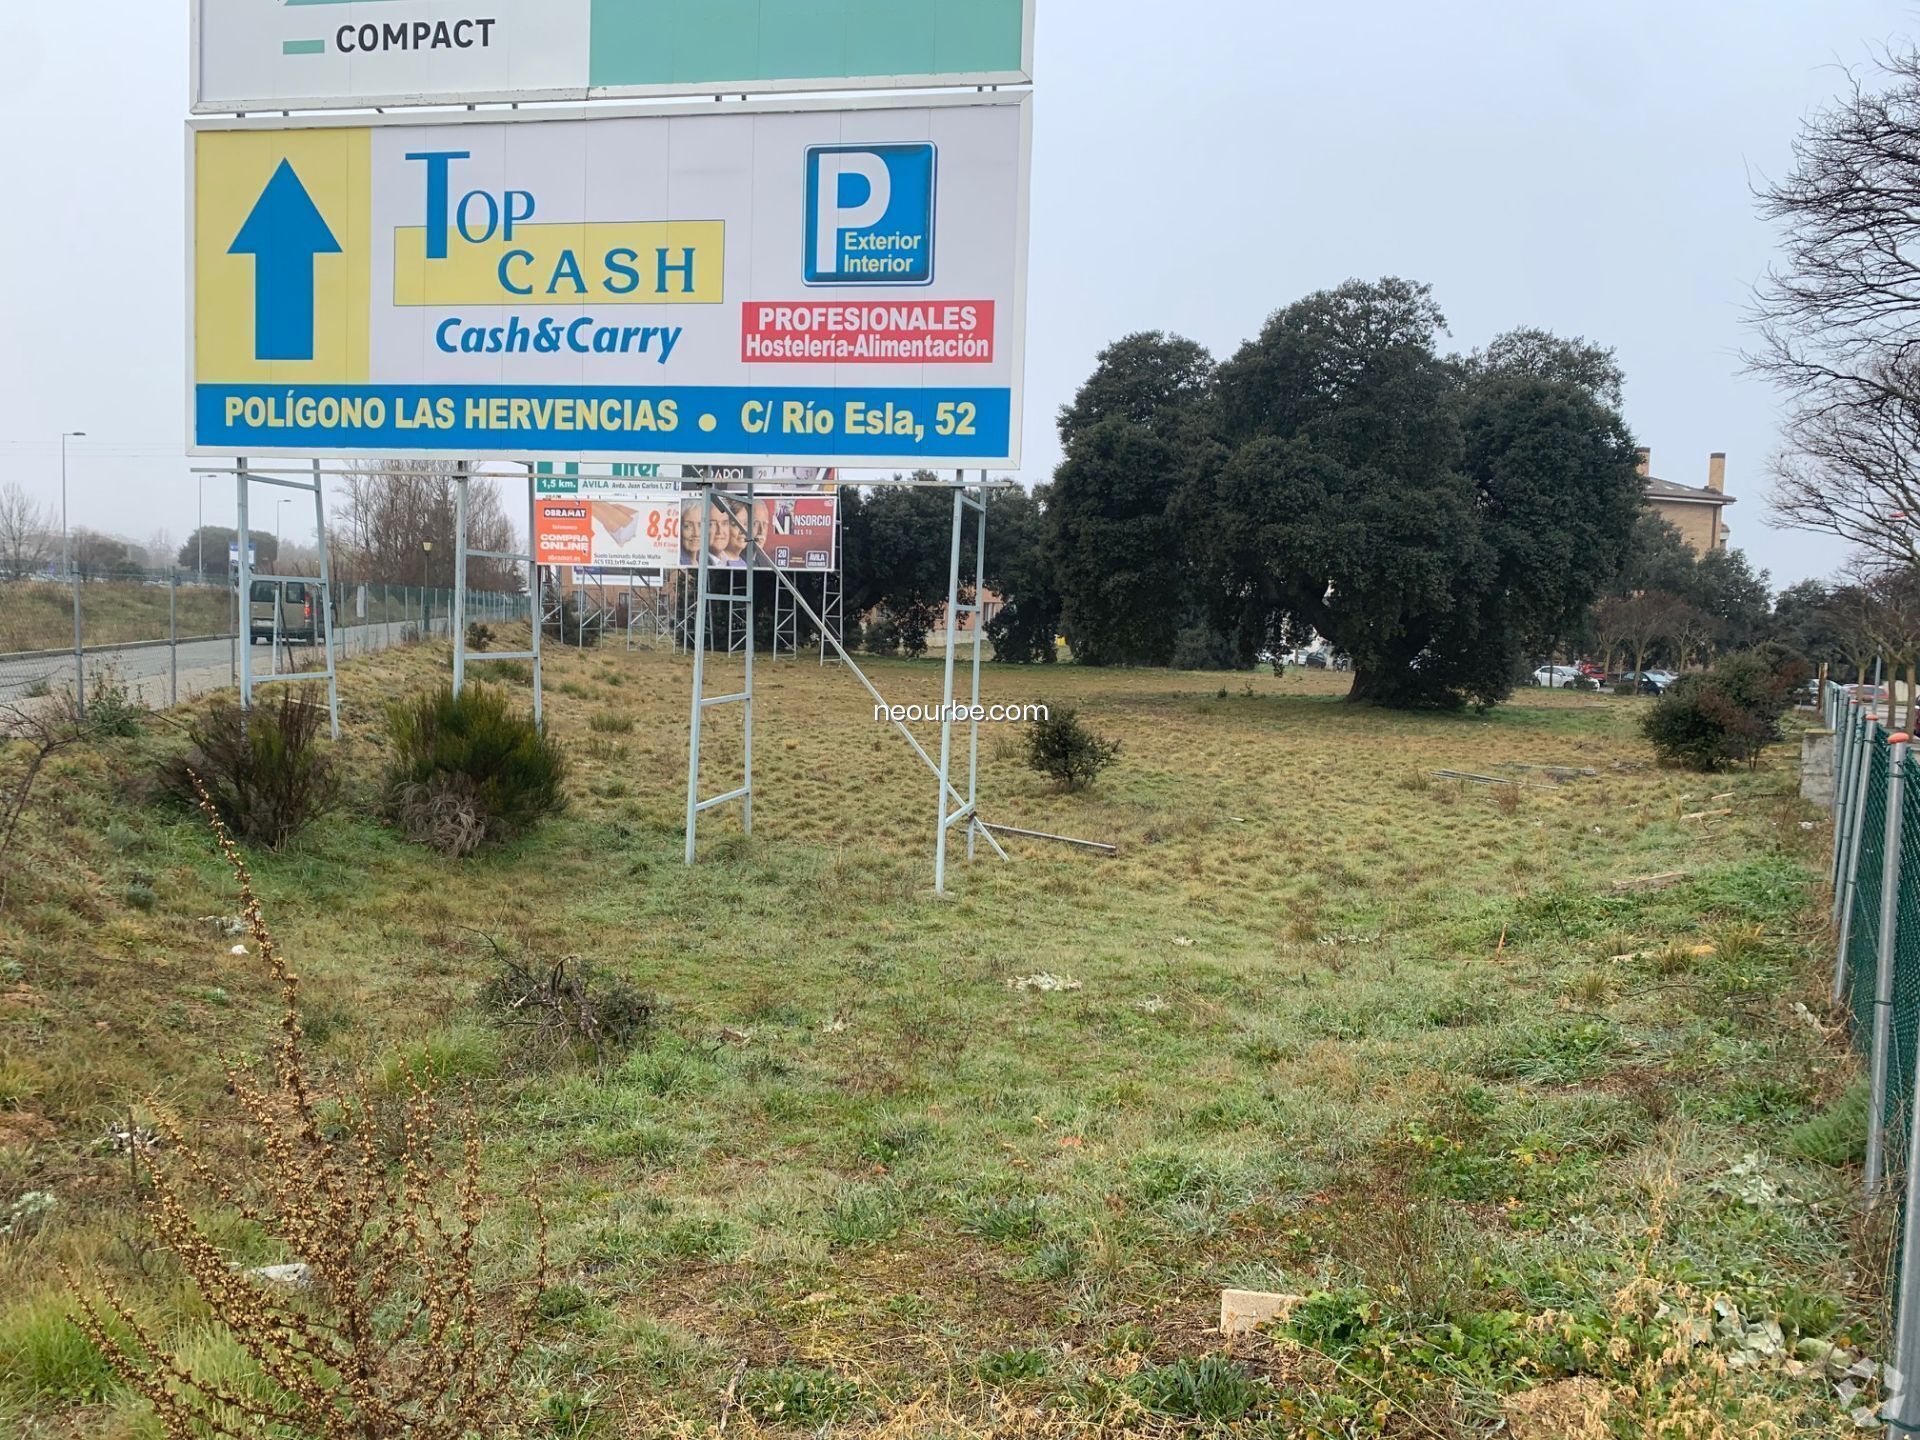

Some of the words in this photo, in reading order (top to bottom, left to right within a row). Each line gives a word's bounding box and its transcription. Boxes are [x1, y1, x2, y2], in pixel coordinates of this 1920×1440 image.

[336, 18, 496, 53] COMPACT
[816, 152, 891, 273] P
[844, 231, 921, 250] Exterior
[497, 247, 696, 295] CASH
[844, 254, 913, 273] Interior
[758, 306, 977, 331] PROFESIONALES
[435, 316, 683, 365] Cash&Carry
[746, 333, 988, 357] Hostelería-Alimentación
[225, 389, 386, 428] POLÍGONO
[395, 397, 455, 429] LAS
[465, 398, 678, 431] HERVENCIAS
[741, 400, 773, 433] C/
[782, 401, 834, 434] Río
[845, 402, 924, 443] Esla,
[935, 402, 976, 435] 52
[542, 479, 556, 489] 1,5
[558, 479, 576, 488] km.
[544, 509, 586, 517] OBRAMAT
[540, 541, 589, 551] ONLINE
[777, 549, 787, 558] 20
